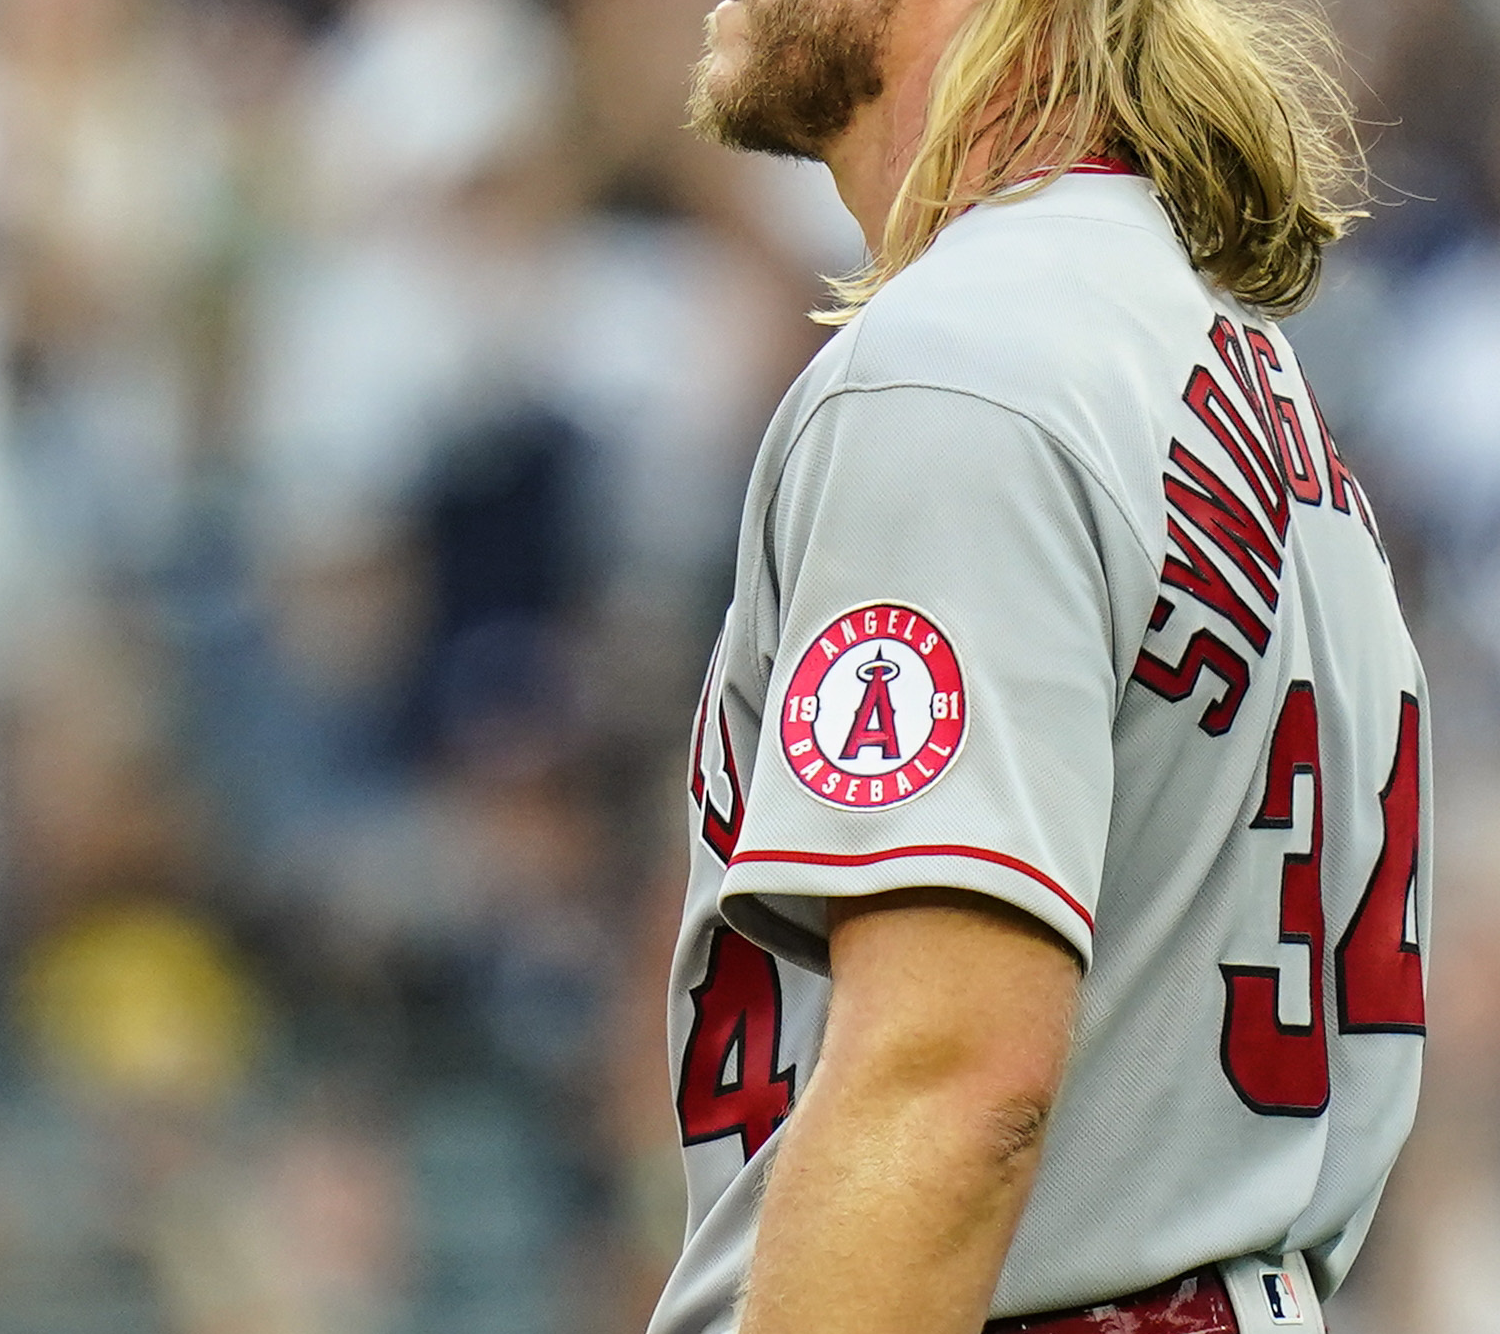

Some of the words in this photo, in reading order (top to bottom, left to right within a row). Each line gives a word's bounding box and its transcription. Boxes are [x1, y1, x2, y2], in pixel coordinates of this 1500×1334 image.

[818, 610, 938, 660] ANGELS
[788, 695, 819, 722] 19
[932, 691, 959, 719] 61
[788, 738, 952, 802] BASEBALL
